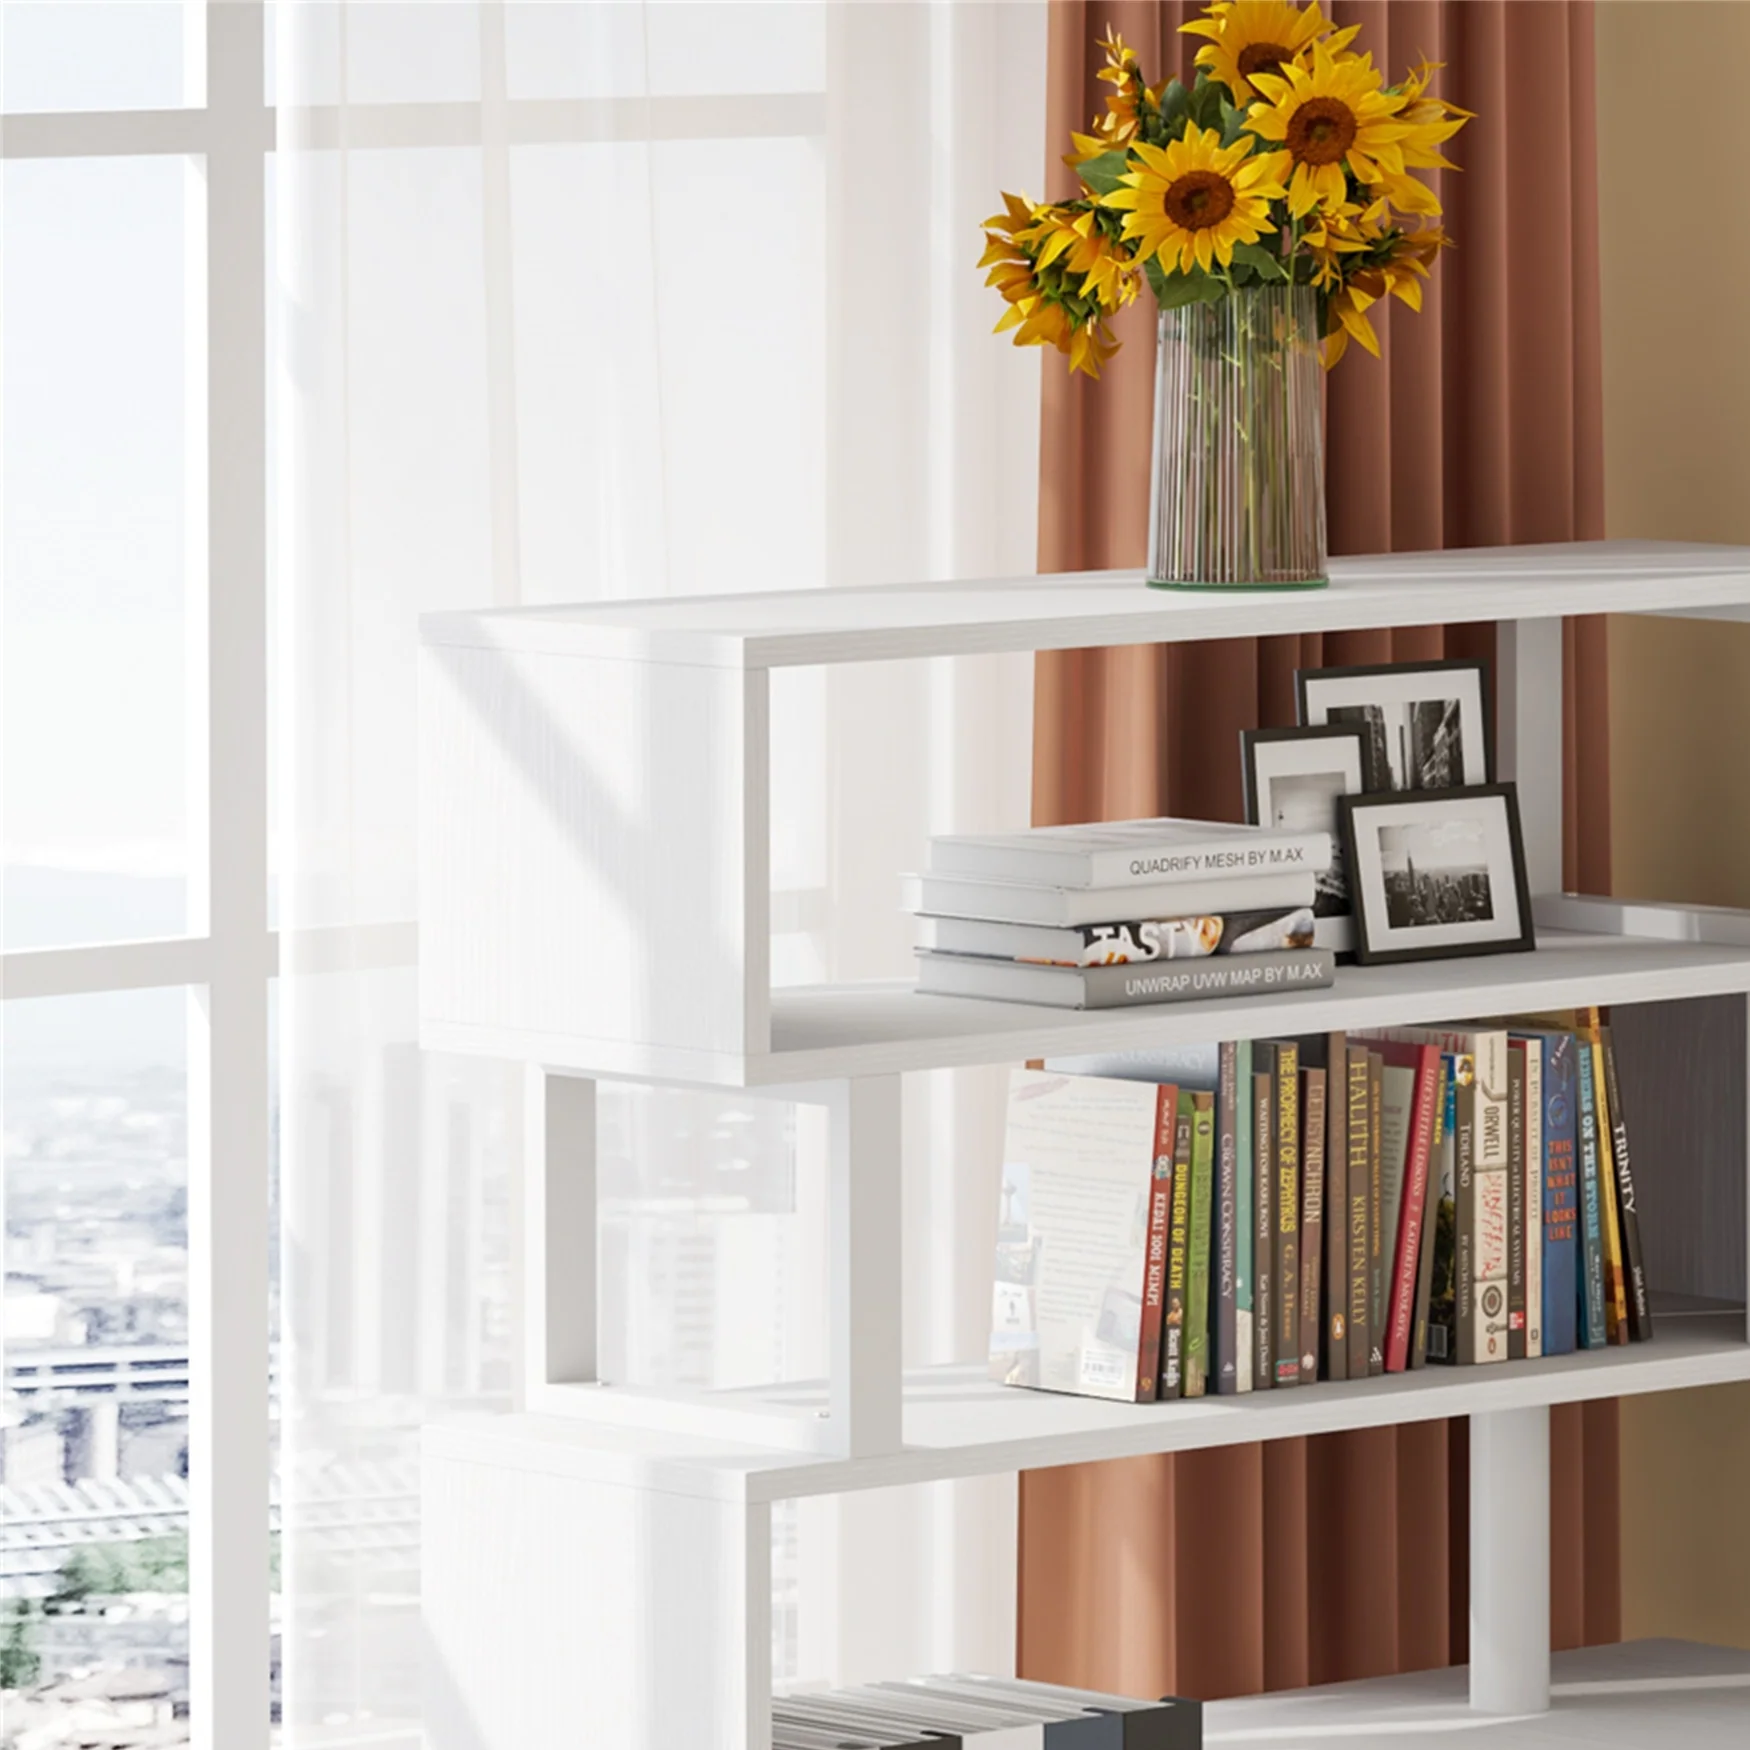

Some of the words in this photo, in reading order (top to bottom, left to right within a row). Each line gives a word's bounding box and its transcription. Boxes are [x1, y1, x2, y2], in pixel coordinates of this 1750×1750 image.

[1129, 855, 1202, 876] QUADRIFY
[1204, 852, 1245, 869] MESH
[1247, 850, 1267, 866] BY
[1269, 846, 1304, 863] M.AX
[1092, 917, 1203, 963] TASTY
[1125, 976, 1191, 996] UNWRAP
[1192, 972, 1230, 991] UVW
[1230, 969, 1262, 986] MAP
[1264, 966, 1286, 983] BY
[1286, 962, 1323, 981] M.AX
[1279, 1049, 1297, 1075] THE
[1578, 1047, 1594, 1114] RIDERS
[1279, 1077, 1296, 1145] PROPHECY
[1349, 1061, 1369, 1167] HALITH
[1511, 1078, 1521, 1115] POWER
[1259, 1097, 1269, 1151] WAITING
[1483, 1105, 1500, 1159] ORWELL
[1511, 1117, 1521, 1163] QUALITY
[1582, 1116, 1594, 1139] ON
[1222, 1133, 1233, 1198] CROWN
[1259, 1153, 1268, 1175] FOR
[1279, 1147, 1296, 1165] OF
[1303, 1084, 1323, 1224] GEOSYNCHRON
[1459, 1122, 1472, 1188] TIDELAND
[1547, 1139, 1572, 1154] THIS
[1583, 1141, 1597, 1178] THE
[1613, 1120, 1637, 1214] TRINITY
[1413, 1146, 1427, 1197] LESSONS
[1547, 1172, 1576, 1189] WHAT
[1152, 1191, 1167, 1231] KEDAI
[1173, 1163, 1188, 1224] DUNGEON
[1279, 1167, 1297, 1233] ZEPHYRUS
[1511, 1174, 1521, 1238] ELECTRICAL
[1554, 1191, 1565, 1205] IT
[1585, 1180, 1599, 1239] STORM
[1171, 1227, 1185, 1244] OF
[1352, 1195, 1367, 1271] KIRSTEN
[1545, 1207, 1577, 1224] LOOKS
[1548, 1226, 1573, 1242] LIKE
[1150, 1234, 1163, 1261] 1001
[1170, 1248, 1183, 1289] DEATH
[1221, 1200, 1233, 1299] CONSPIRACY
[1283, 1244, 1294, 1265] G.
[1511, 1239, 1521, 1286] SYSTEMS
[1146, 1264, 1160, 1306] MIMPI
[1283, 1268, 1294, 1288] A.
[1351, 1276, 1367, 1326] KELLY
[1168, 1328, 1181, 1356] Scott
